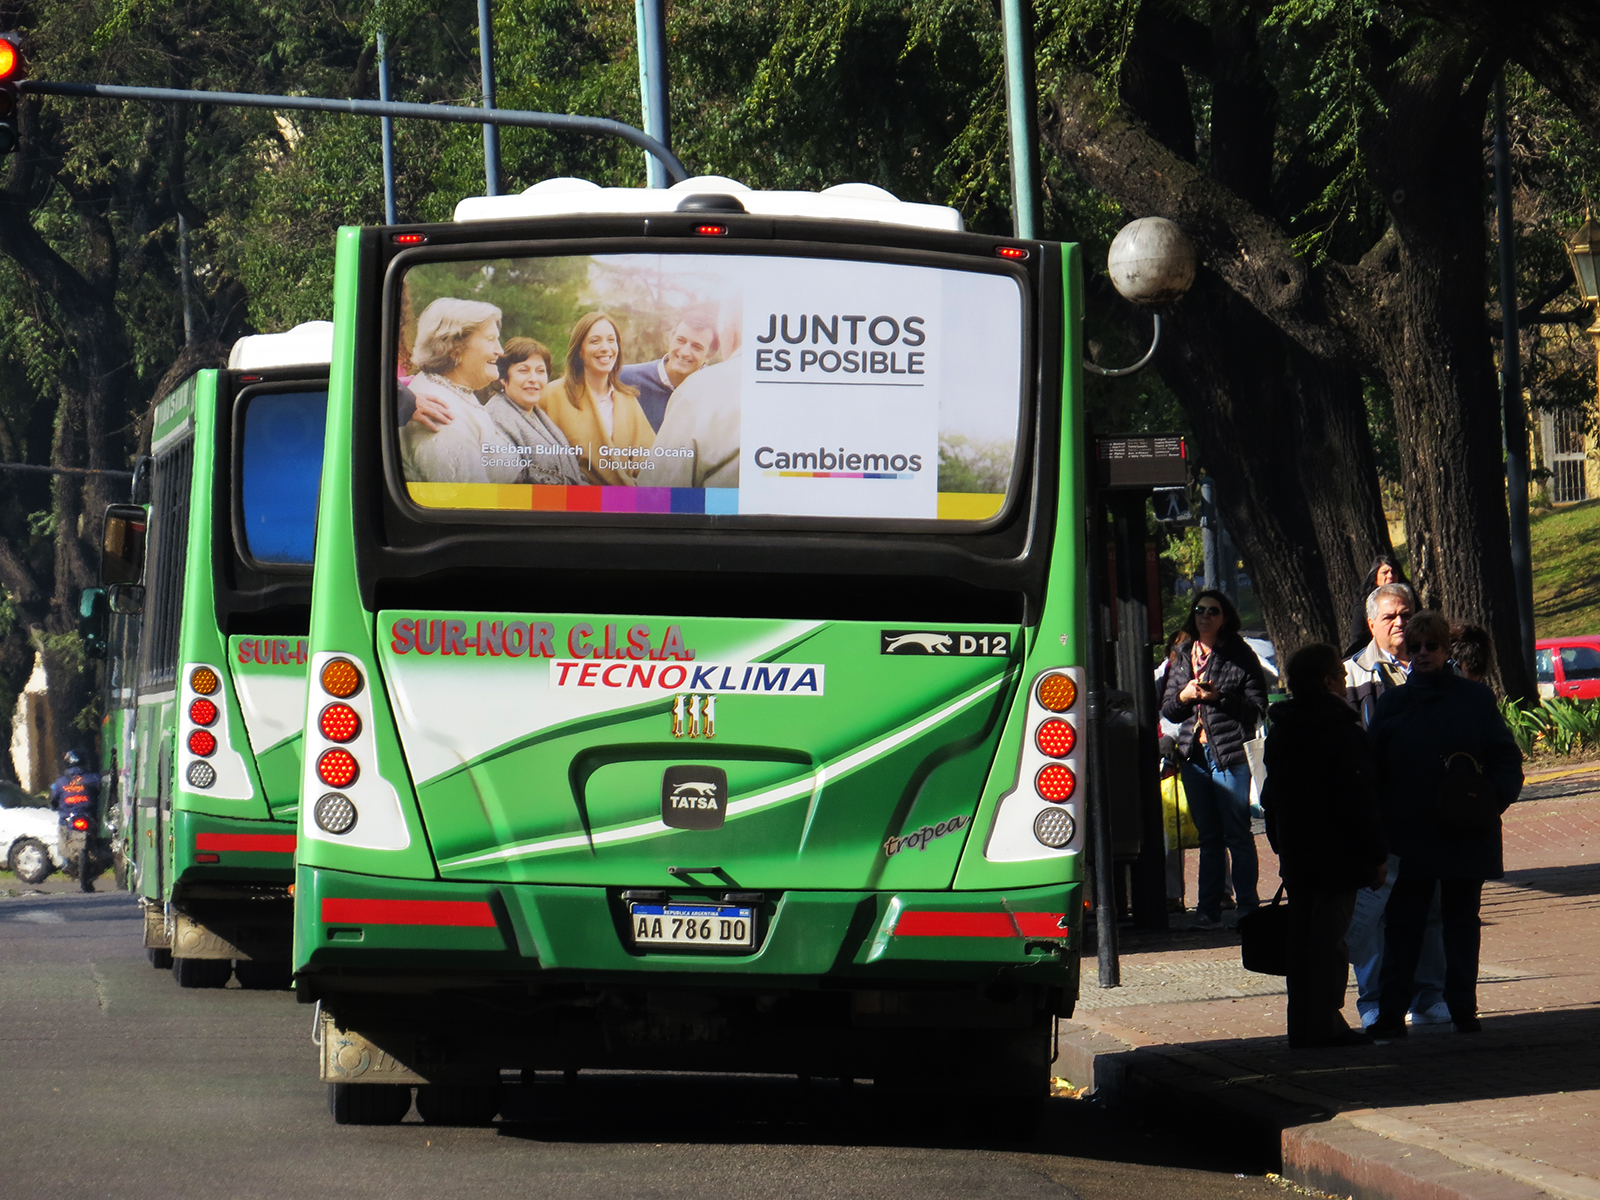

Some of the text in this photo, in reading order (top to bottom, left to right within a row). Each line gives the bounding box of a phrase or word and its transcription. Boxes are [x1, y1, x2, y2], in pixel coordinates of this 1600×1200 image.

[757, 314, 926, 346] JUNTOS
[757, 350, 925, 375] ES POSIBLE
[481, 443, 583, 456] Esteban Bullrich
[598, 445, 695, 458] Graciela Ocaña
[755, 446, 922, 473] Cambiemos
[481, 456, 532, 467] Senador
[598, 459, 655, 471] Diputada
[391, 617, 696, 661] SUR-NOR C.I.S.A.
[960, 636, 1007, 655] D12
[556, 661, 817, 692] TECNOKLIMA
[670, 796, 718, 809] TATSA
[884, 815, 971, 857] tropea
[637, 917, 745, 940] AA 786 DO
